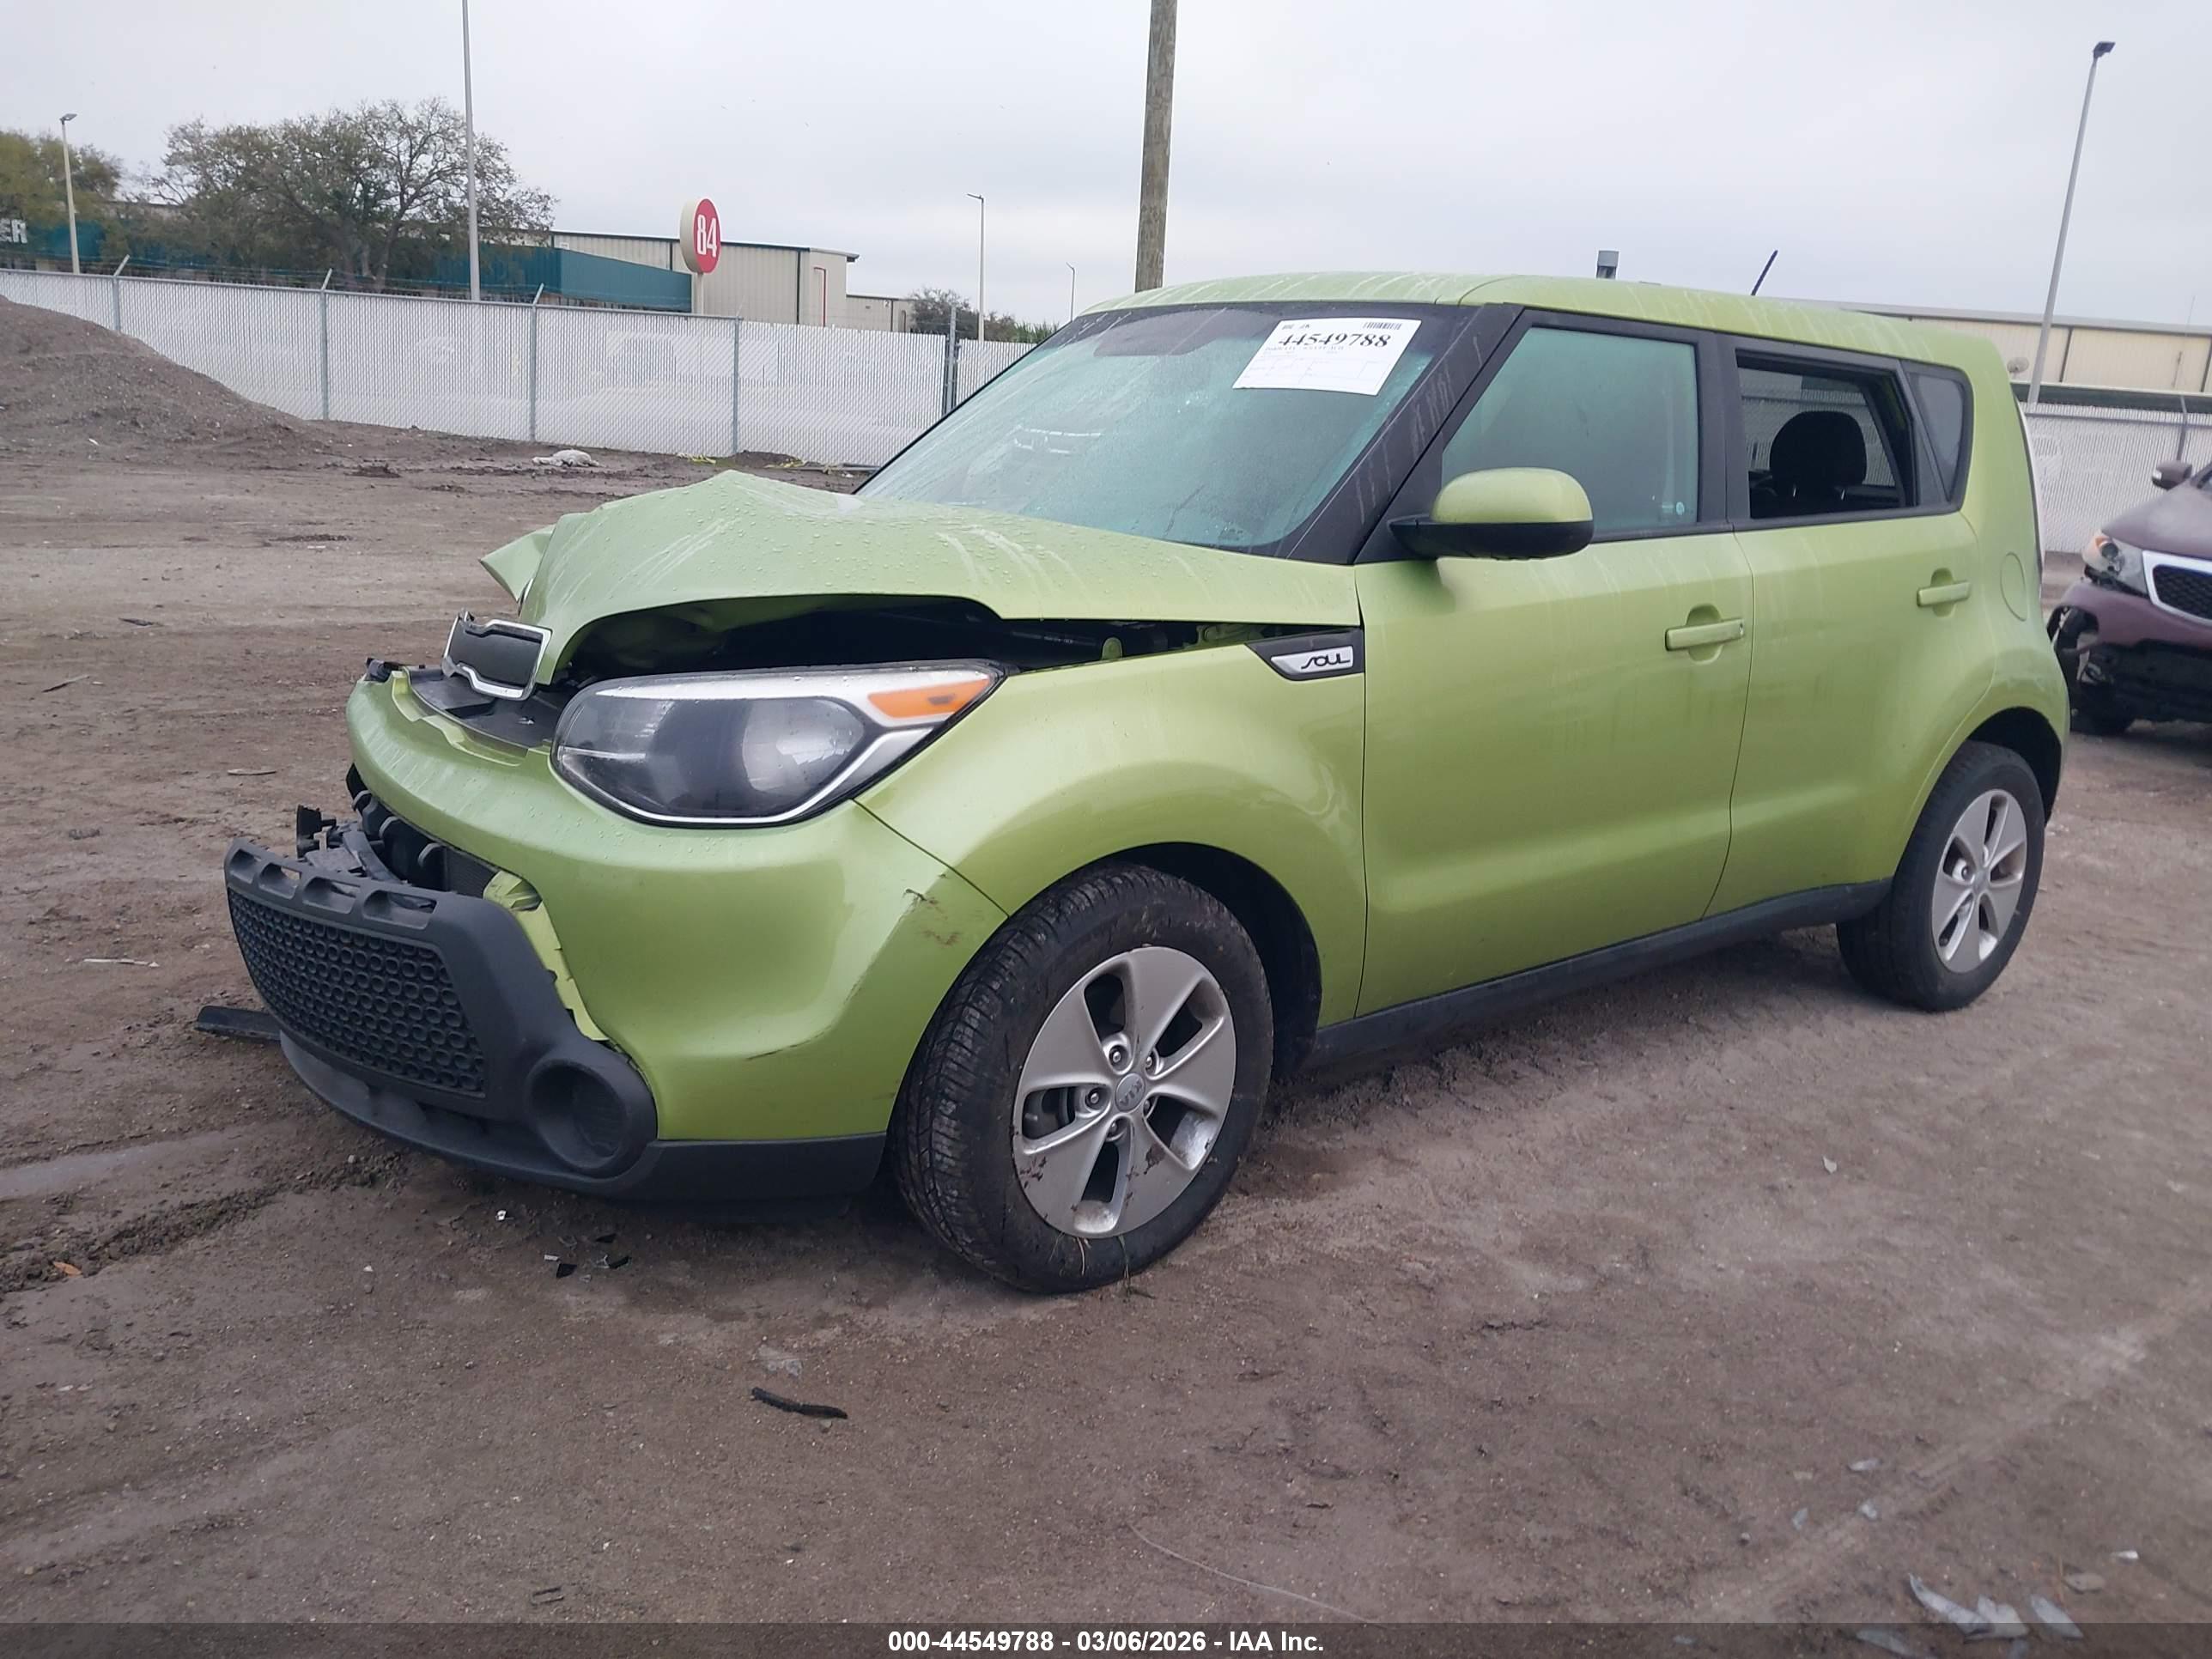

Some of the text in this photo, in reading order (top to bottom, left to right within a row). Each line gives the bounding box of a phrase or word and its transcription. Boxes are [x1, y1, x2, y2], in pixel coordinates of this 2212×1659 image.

[696, 214, 717, 258] 84
[1279, 332, 1391, 347] 44549788
[1301, 653, 1351, 669] SOUL
